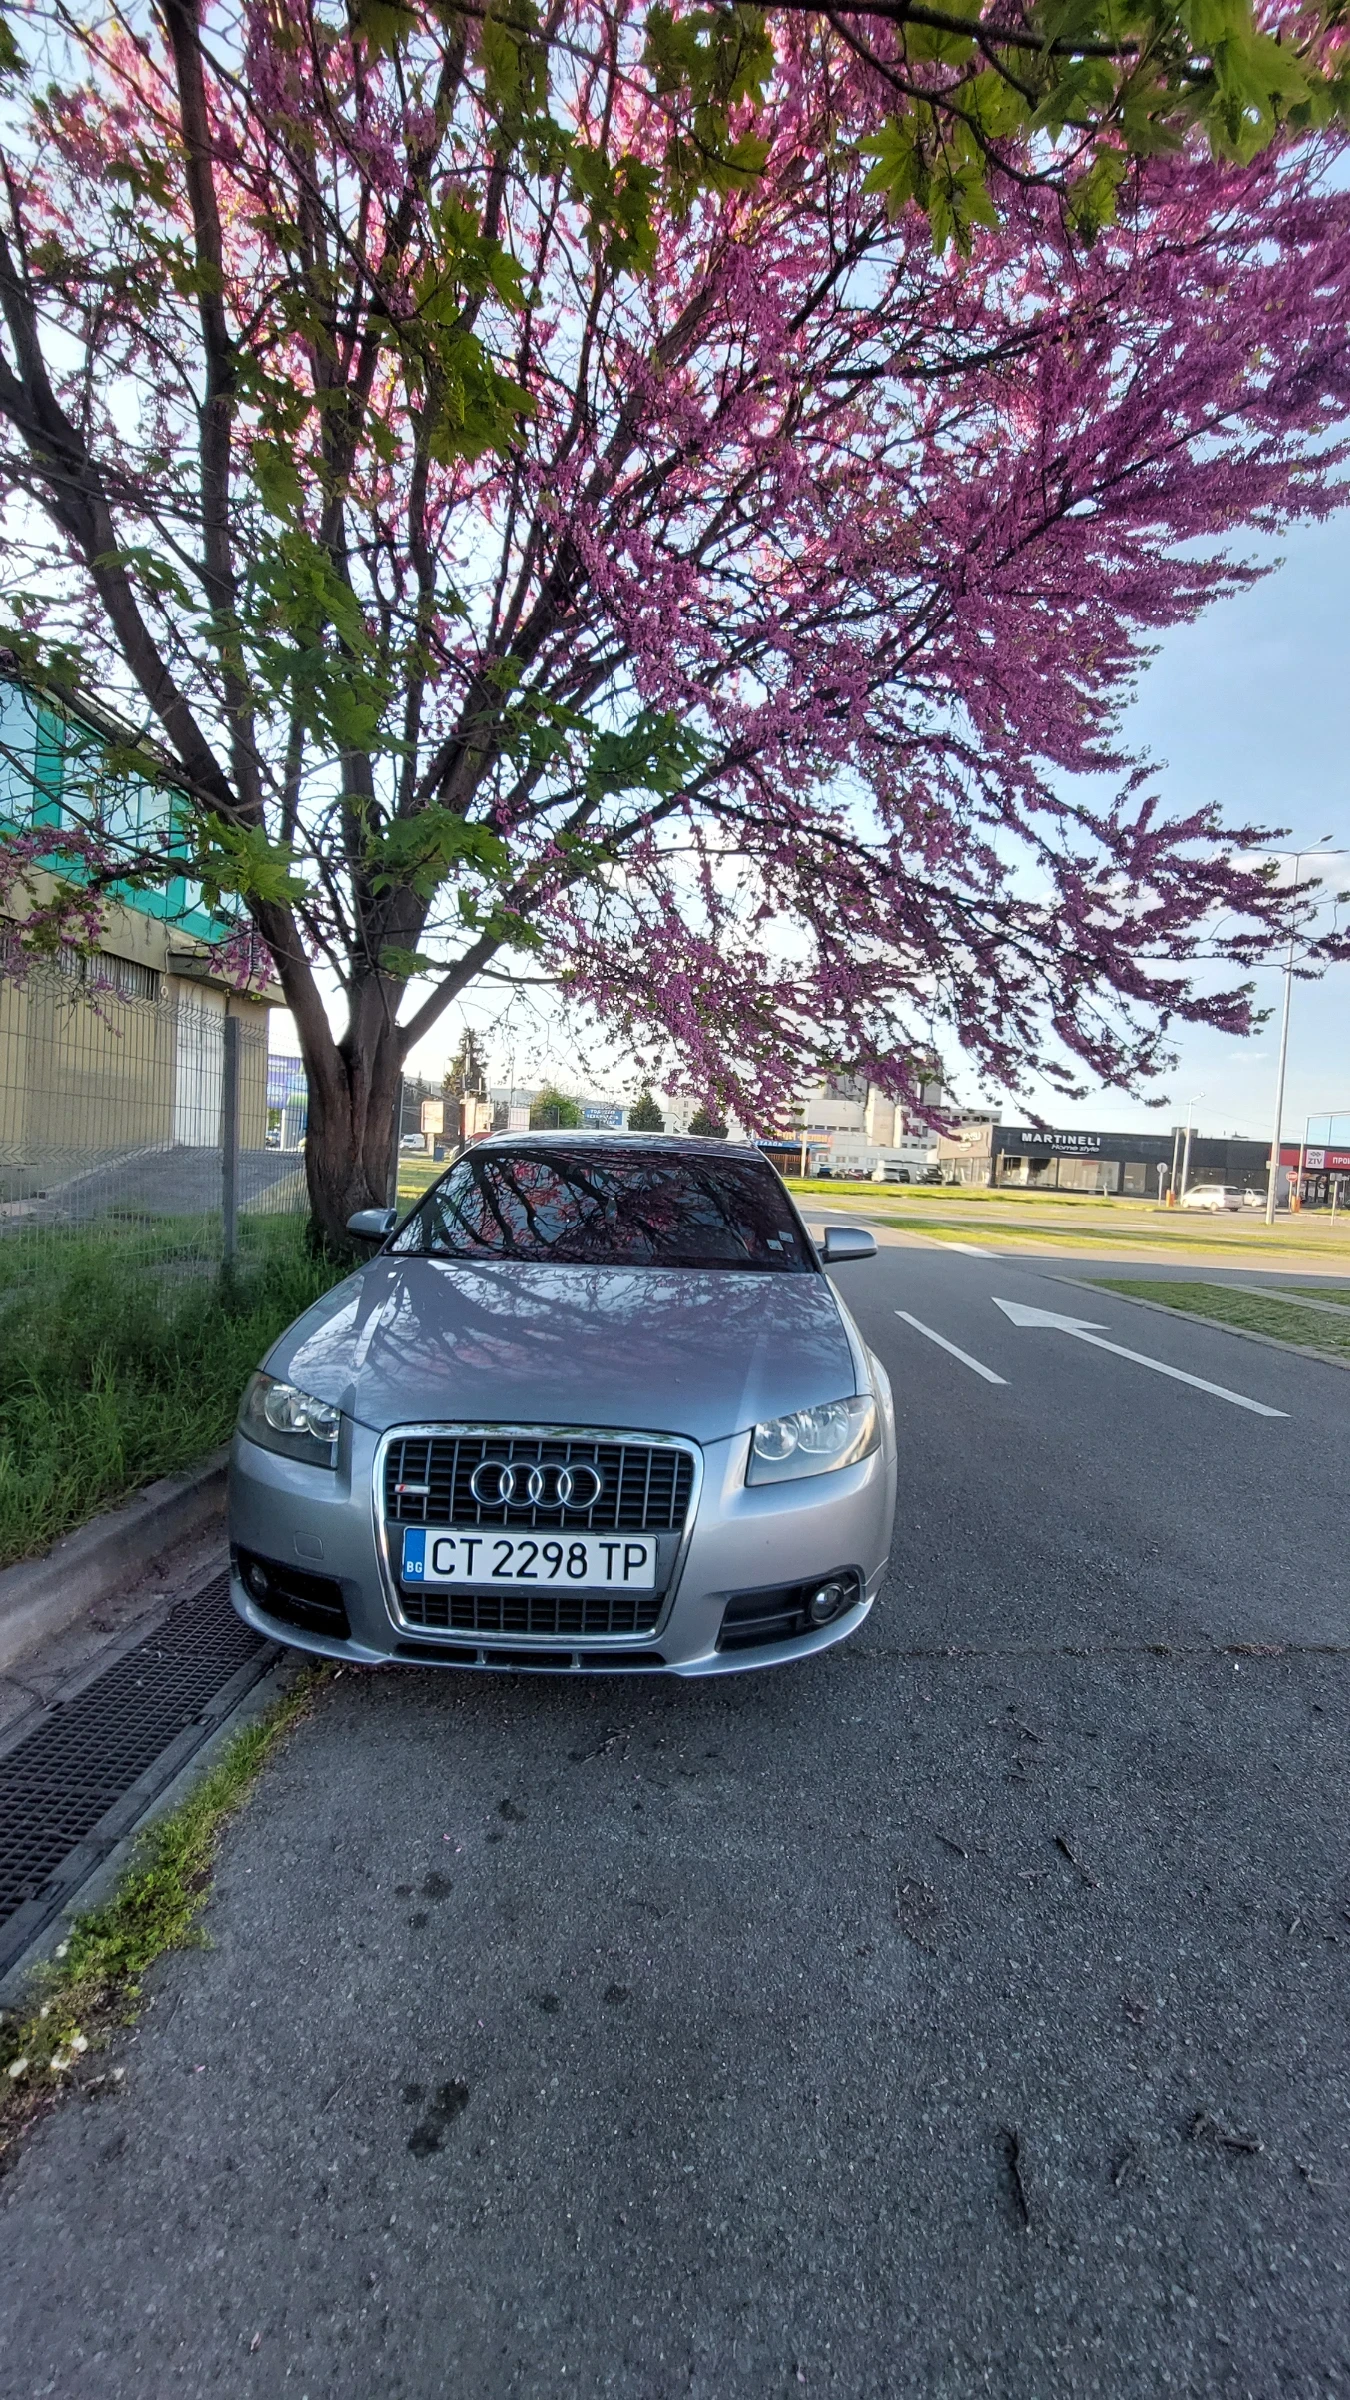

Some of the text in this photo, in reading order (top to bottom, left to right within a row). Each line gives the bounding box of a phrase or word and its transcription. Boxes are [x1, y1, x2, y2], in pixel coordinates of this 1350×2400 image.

[1021, 1132, 1101, 1146] MARTINELI
[1079, 1145, 1100, 1153] style
[432, 1537, 648, 1581] CT 2298 TP
[406, 1561, 423, 1574] BG
